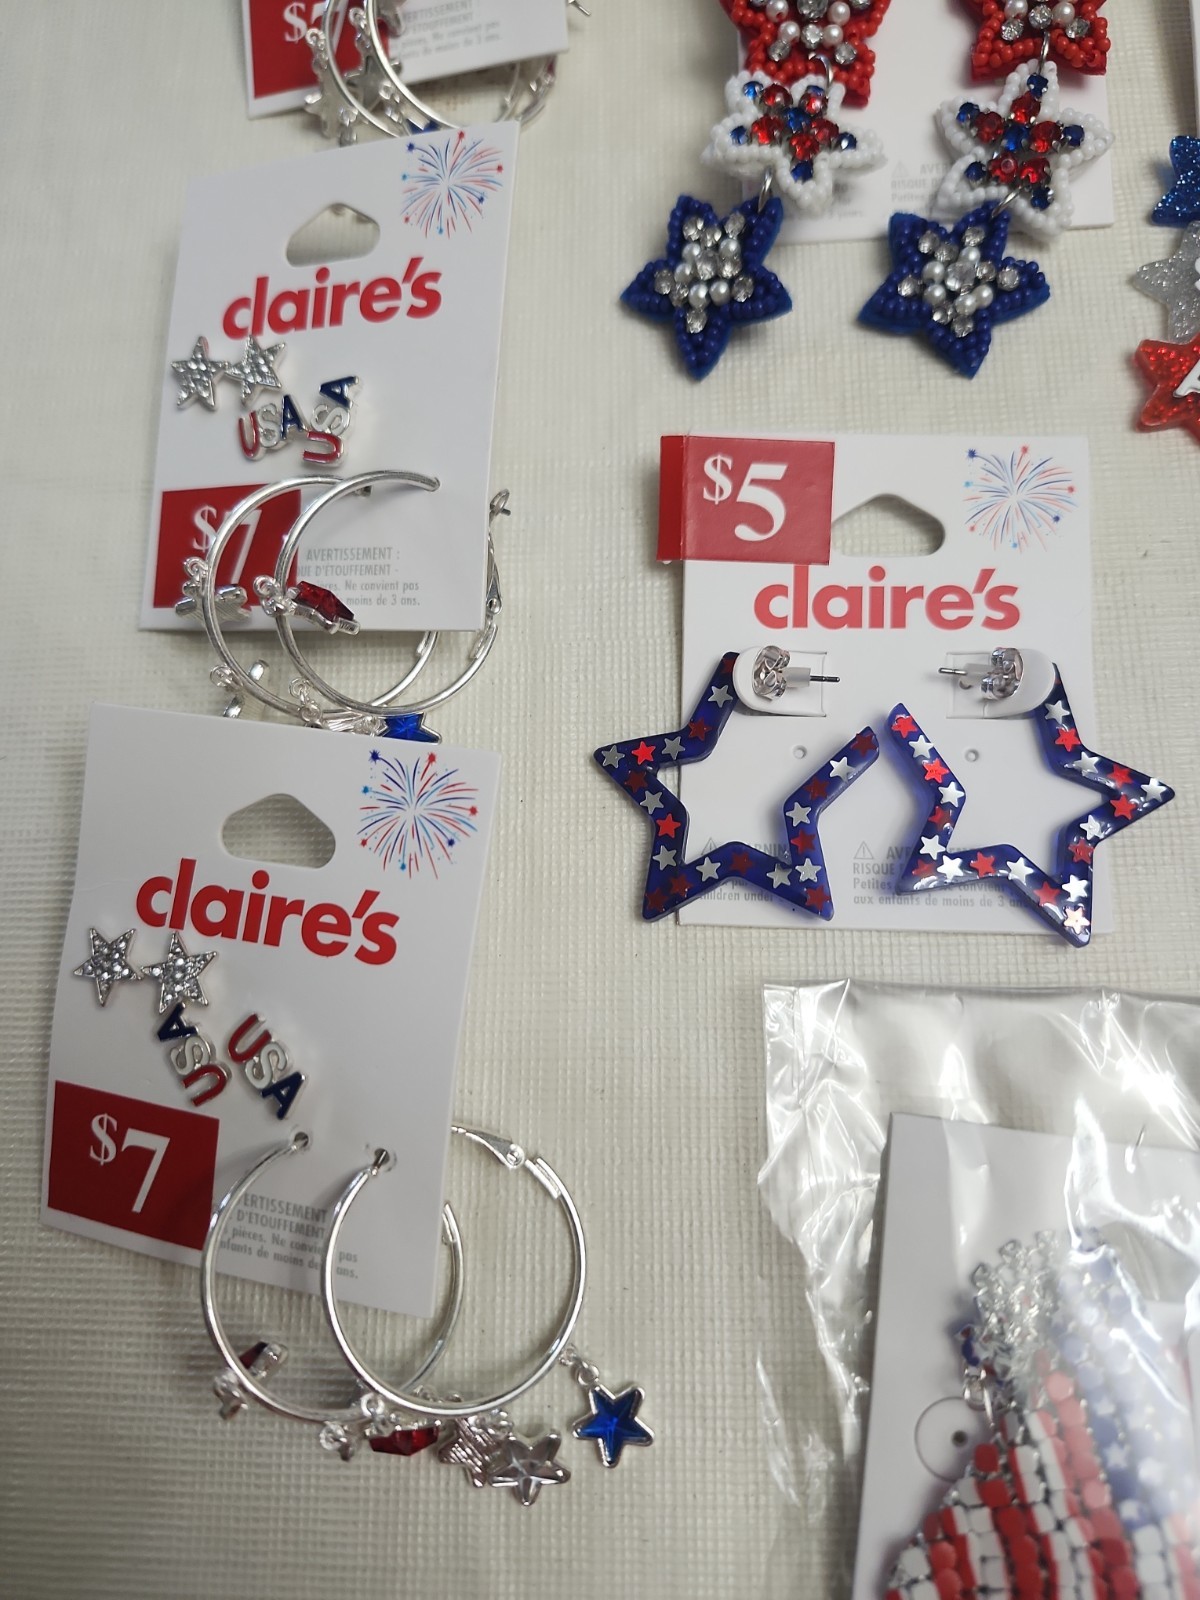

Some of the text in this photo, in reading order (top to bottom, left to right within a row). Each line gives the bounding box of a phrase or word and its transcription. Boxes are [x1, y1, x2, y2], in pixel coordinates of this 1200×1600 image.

[222, 256, 443, 341] claire's
[237, 394, 308, 462] USA
[304, 375, 359, 466] USA
[702, 453, 788, 542] $5
[306, 547, 394, 562] AVERTISSEMENT
[345, 580, 357, 591] Ne
[360, 580, 399, 591] convient
[402, 581, 420, 593] pas
[346, 594, 421, 606] moins de 3 ans.
[753, 563, 1021, 631] claire's
[852, 862, 895, 875] RISQUE
[853, 895, 875, 905] aux
[878, 892, 921, 905] enfants
[924, 893, 938, 906] de
[942, 894, 974, 907] moins
[979, 894, 993, 907] de
[998, 896, 1005, 908] 3
[135, 857, 400, 966] claire's
[157, 1001, 233, 1107] USA
[227, 1012, 307, 1120] USA
[89, 1112, 171, 1214] $7
[237, 1192, 328, 1224] ERTISSEMENT
[220, 1238, 253, 1256] nfants
[256, 1245, 270, 1259] de
[273, 1251, 304, 1267] moins
[271, 1233, 288, 1248] Ne
[338, 1250, 359, 1264] pas
